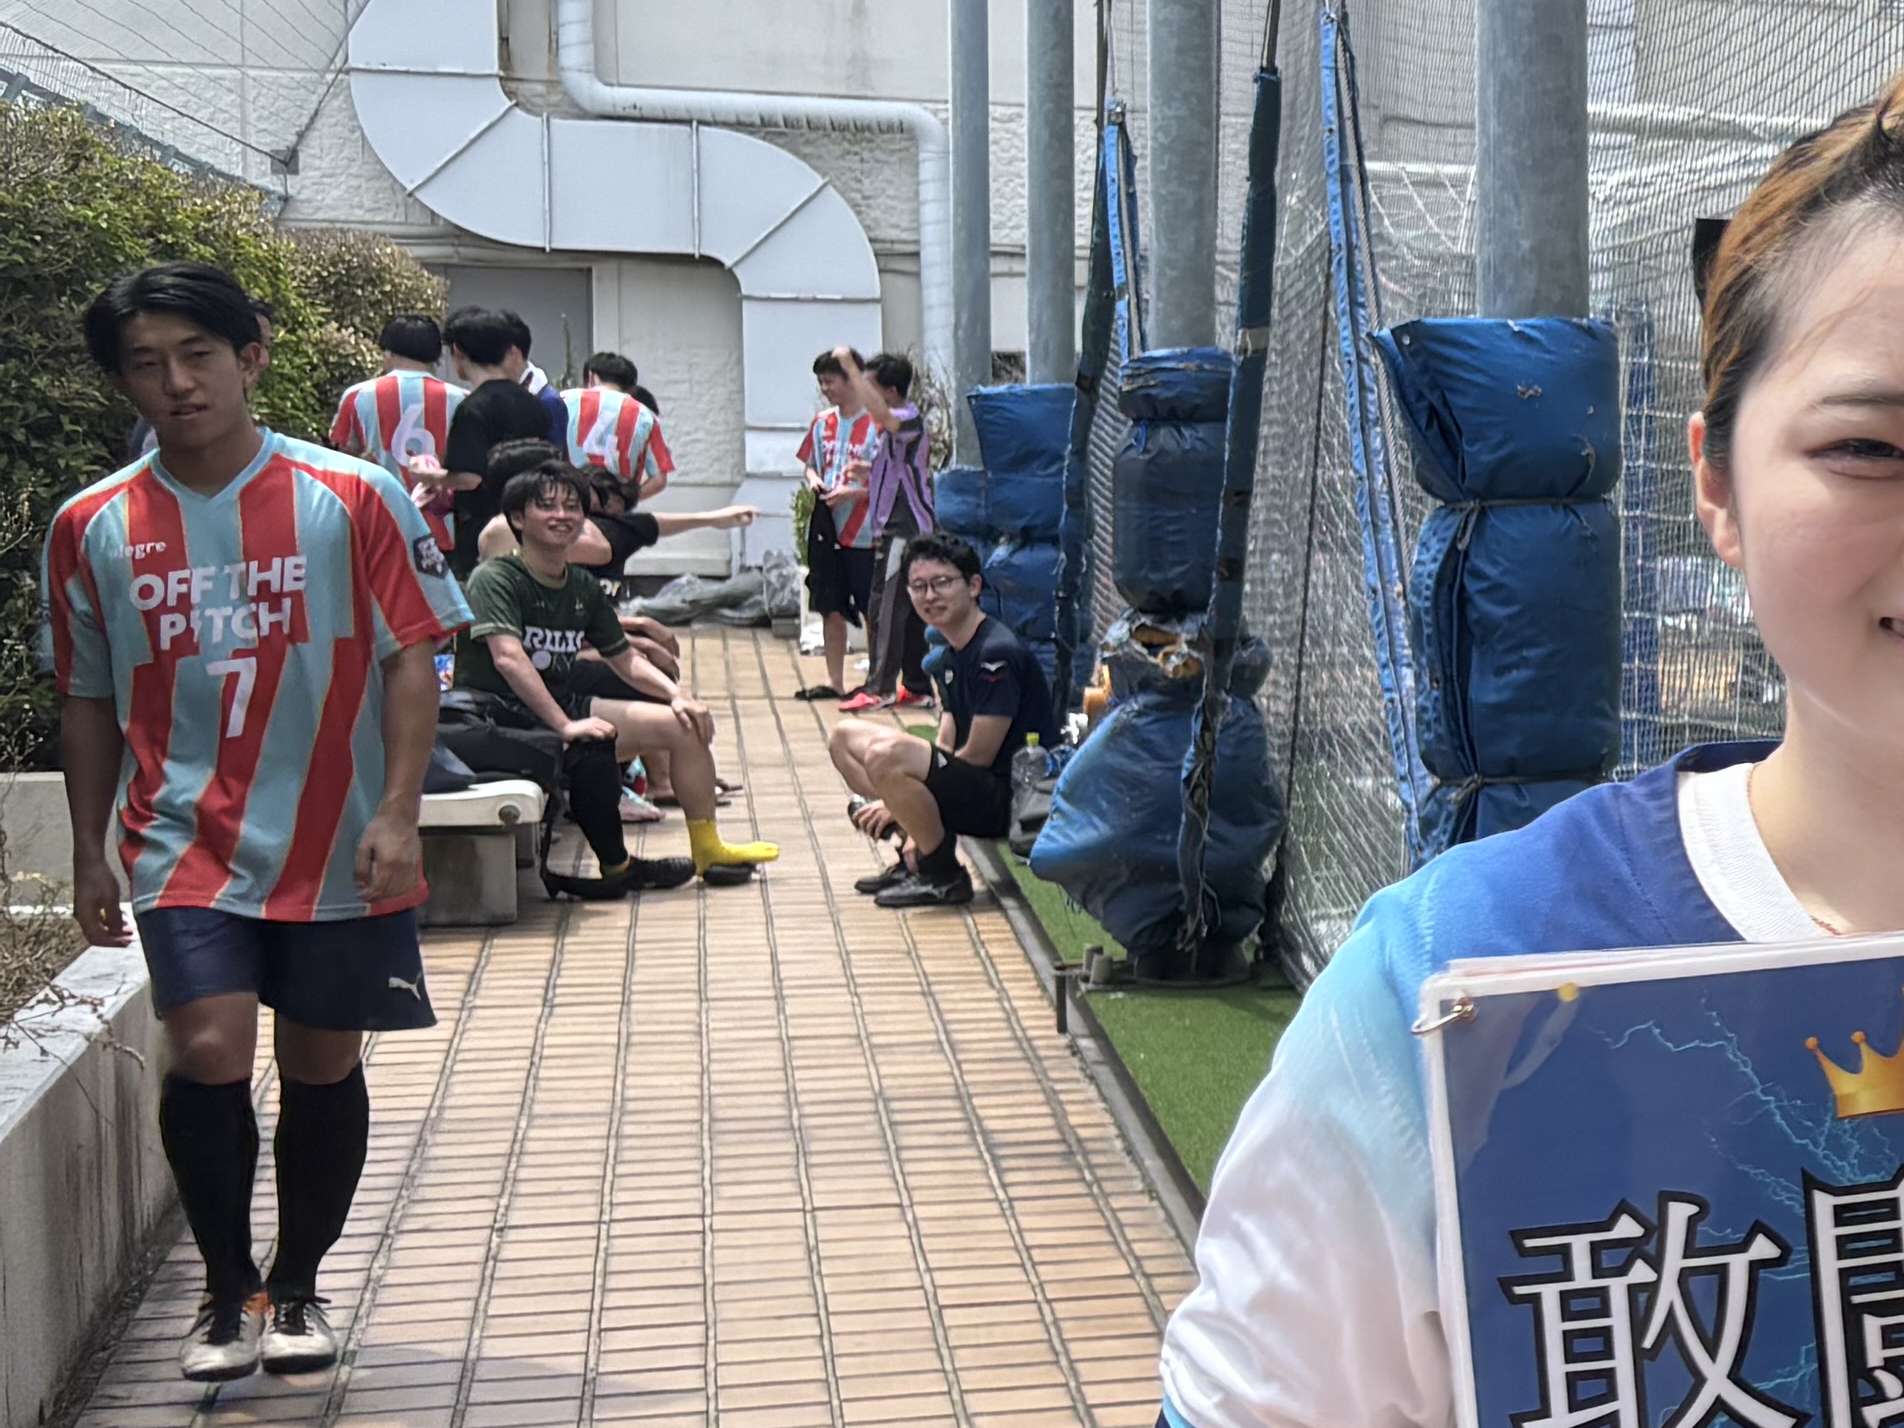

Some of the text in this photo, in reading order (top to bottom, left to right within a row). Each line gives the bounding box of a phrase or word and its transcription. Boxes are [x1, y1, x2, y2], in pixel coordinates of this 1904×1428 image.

[391, 403, 435, 467] 6
[583, 410, 619, 473] 4
[129, 555, 307, 611] OFF THE
[206, 656, 257, 739] 7
